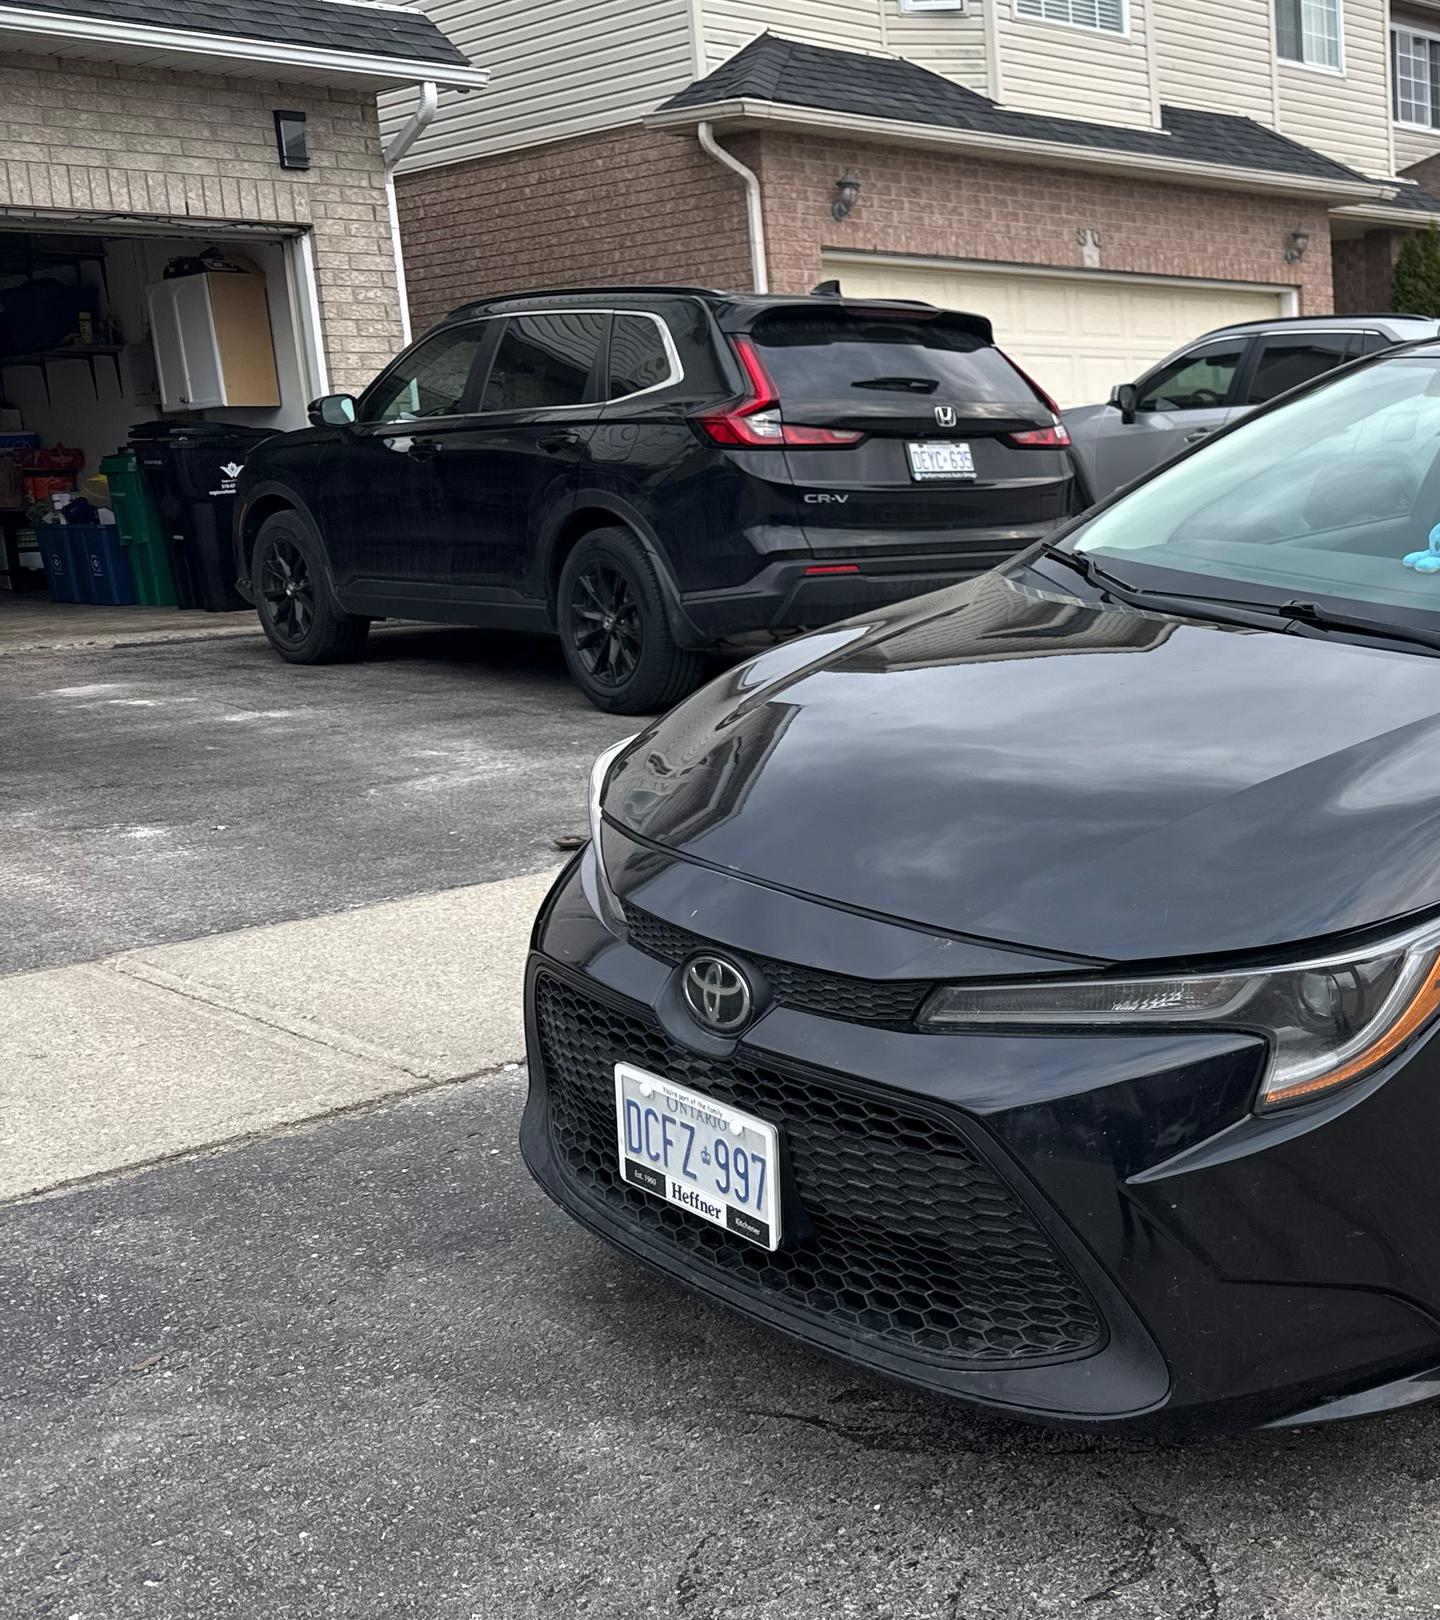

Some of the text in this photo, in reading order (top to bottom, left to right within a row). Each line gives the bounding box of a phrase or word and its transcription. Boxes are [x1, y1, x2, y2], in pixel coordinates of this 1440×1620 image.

[949, 450, 974, 469] 635
[666, 1096, 727, 1132] ONTARIO
[626, 1098, 767, 1211] DCFZ 997
[671, 1181, 722, 1220] Heffner
